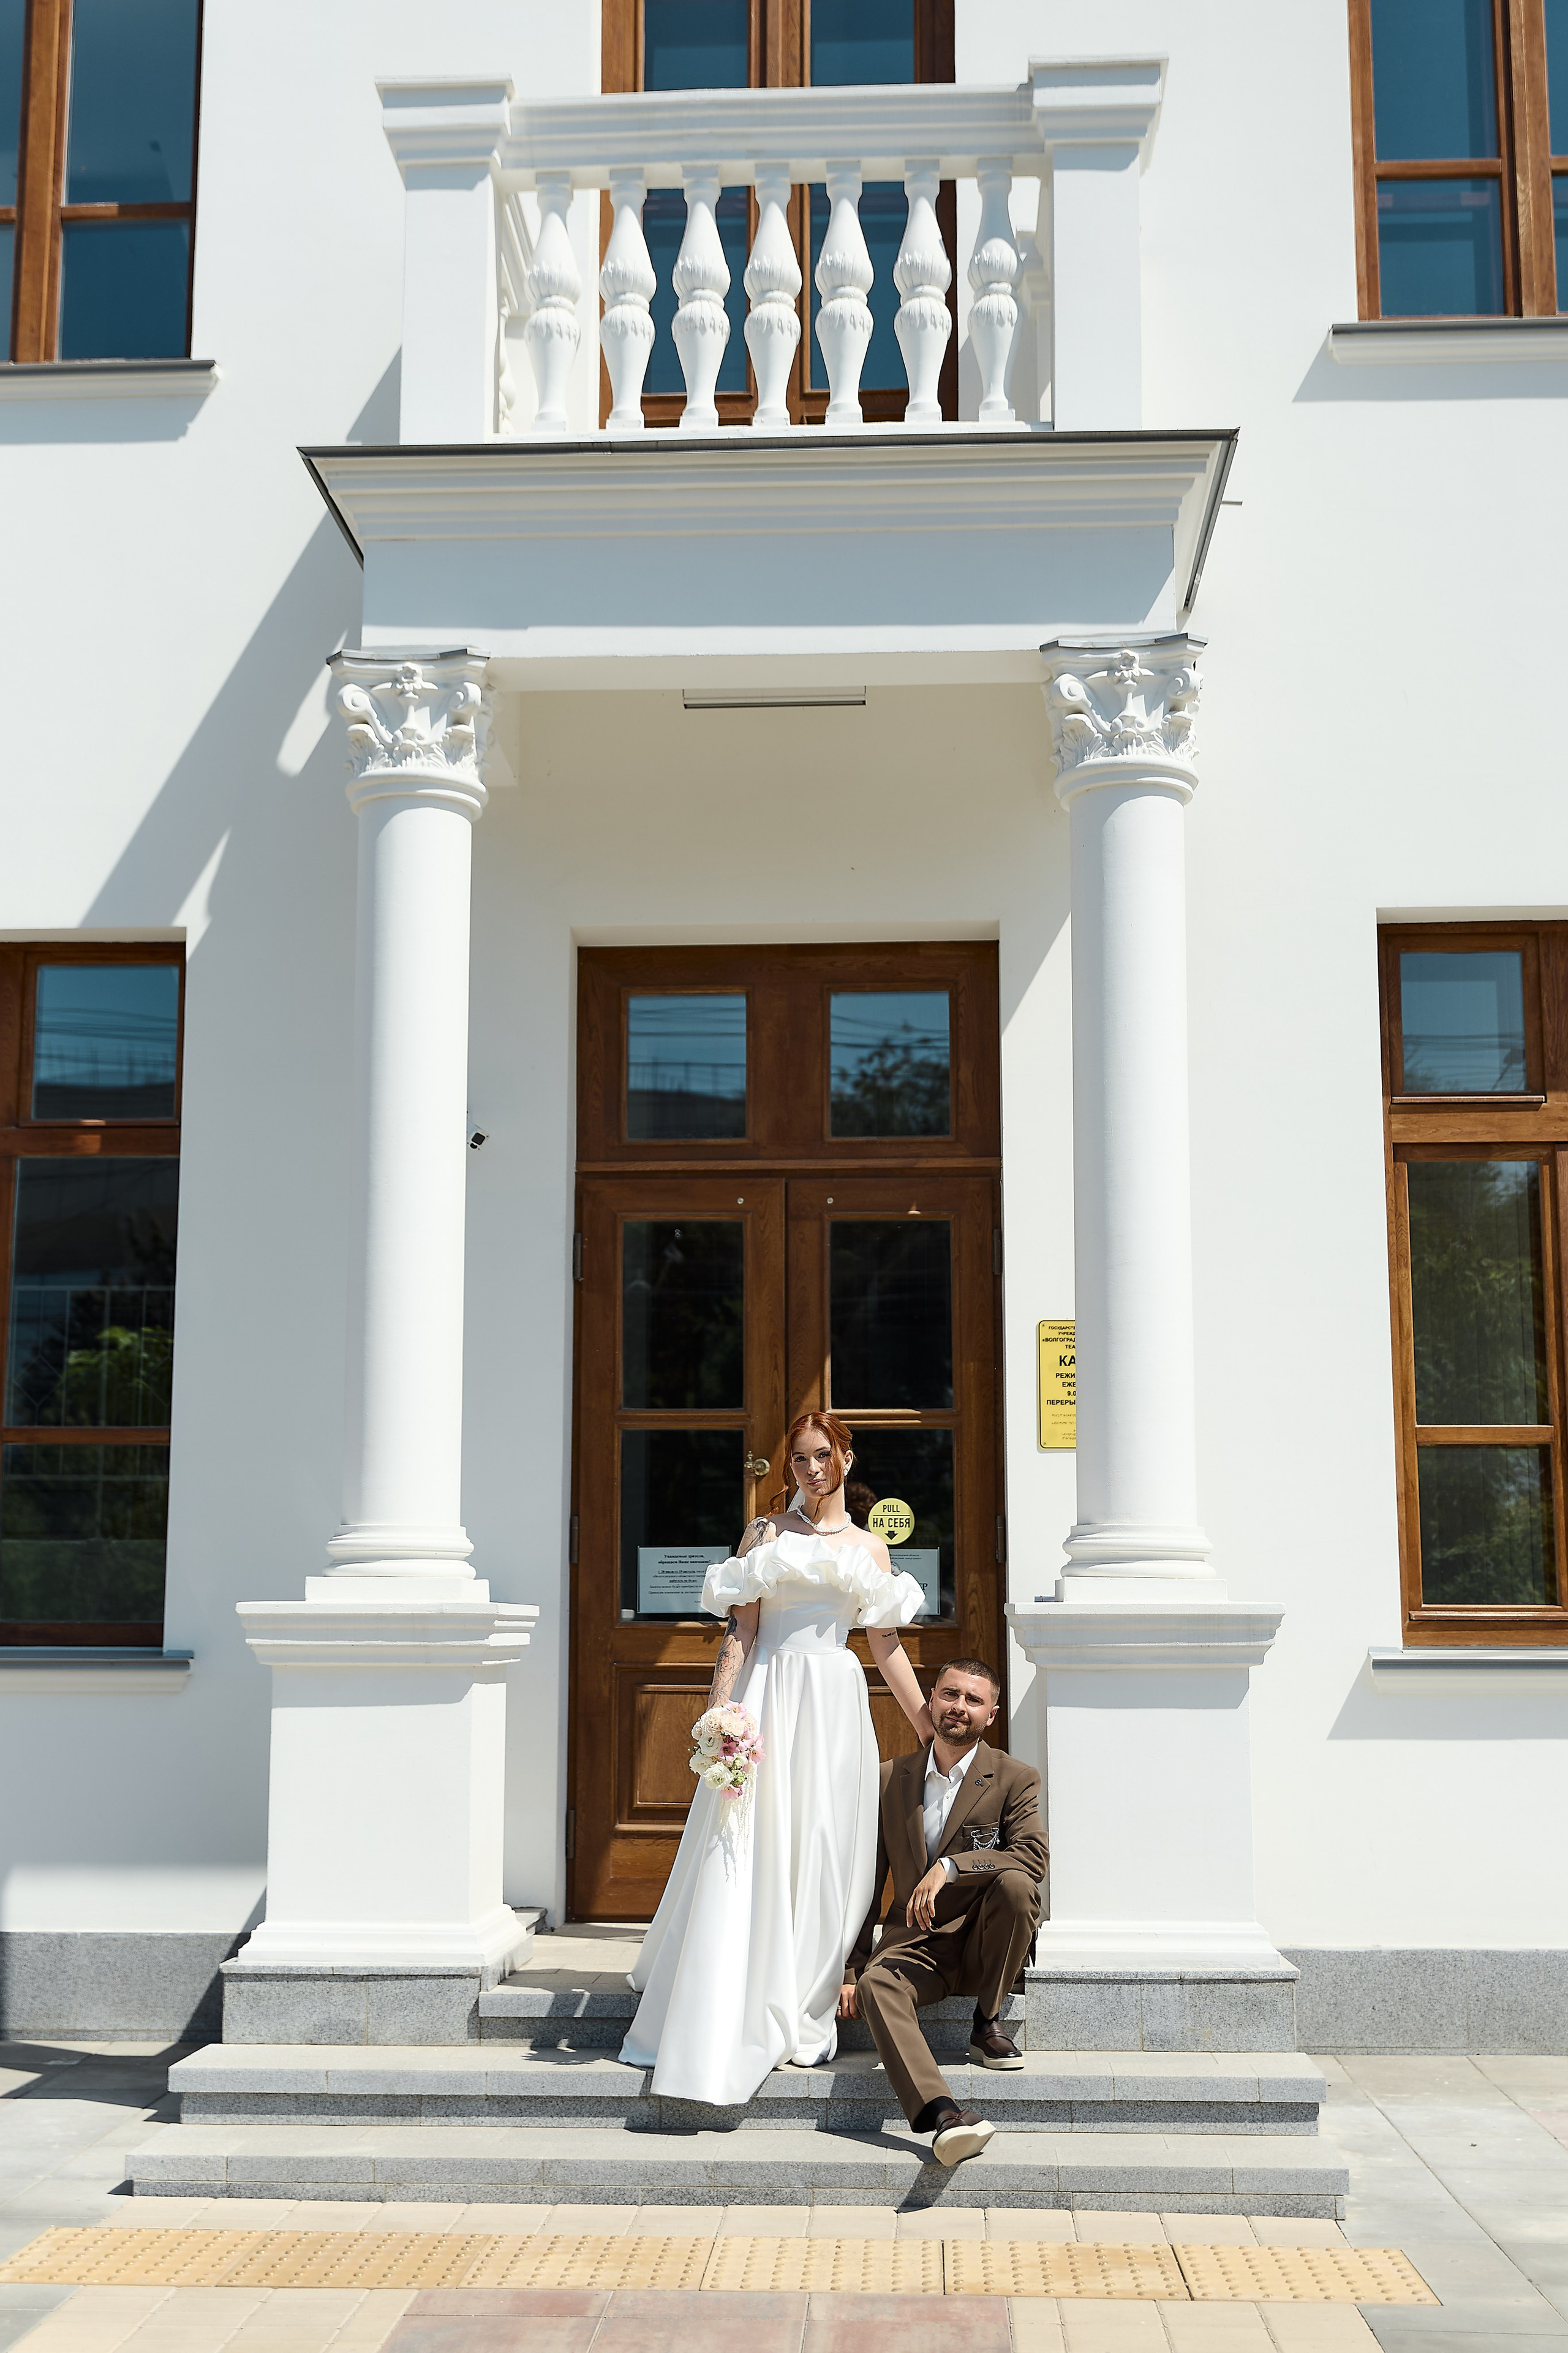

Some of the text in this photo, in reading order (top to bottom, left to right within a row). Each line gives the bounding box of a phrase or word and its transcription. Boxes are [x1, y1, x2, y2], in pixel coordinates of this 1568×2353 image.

[1059, 1355, 1076, 1366] КА
[873, 1518, 910, 1528] НА СЕБЯ
